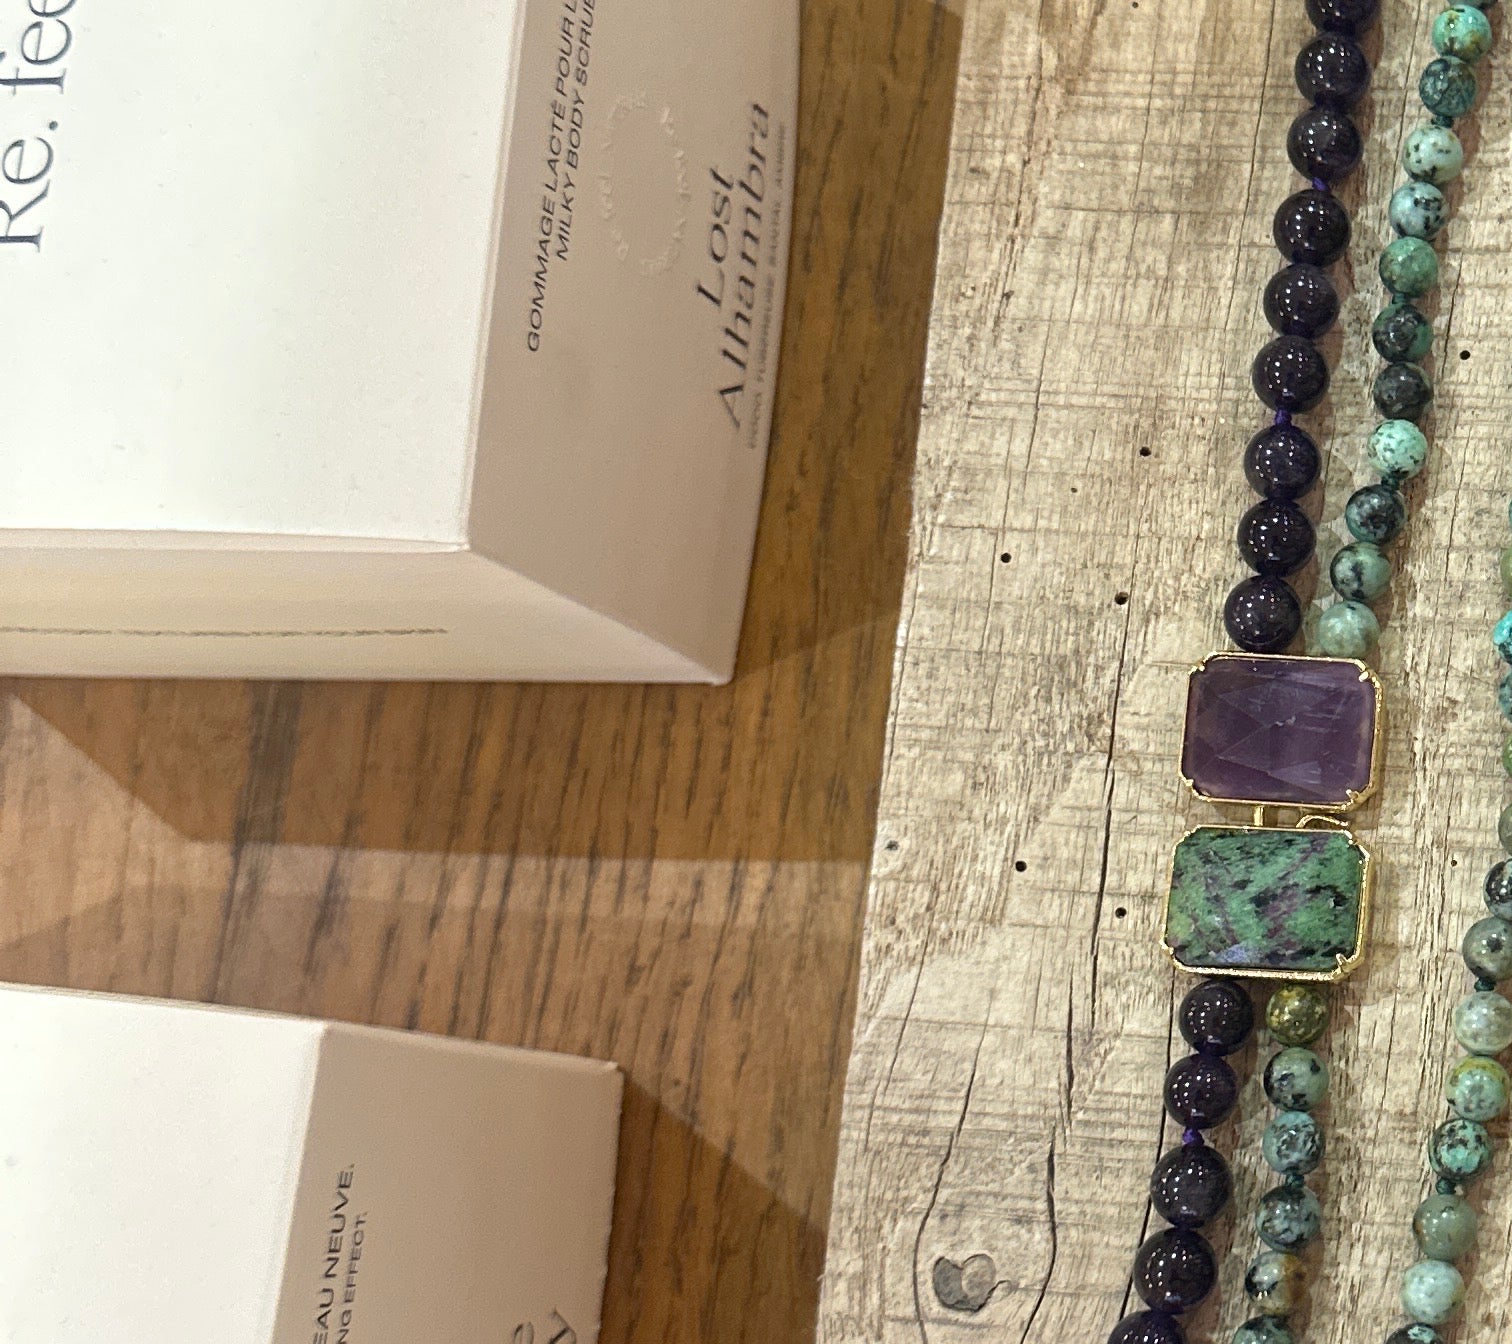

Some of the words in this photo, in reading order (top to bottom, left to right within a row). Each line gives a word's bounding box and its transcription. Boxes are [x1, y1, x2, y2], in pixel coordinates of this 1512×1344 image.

[555, 16, 575, 97] POUR
[544, 99, 567, 193] LACTÉ
[556, 172, 576, 261] MILKY
[567, 89, 585, 170] BODY
[527, 195, 556, 352] GOMMAGE
[696, 165, 734, 308] Lost
[719, 103, 769, 429] Alhambra
[324, 1163, 355, 1278] NEUVE.
[344, 1211, 368, 1303] EFFECT.
